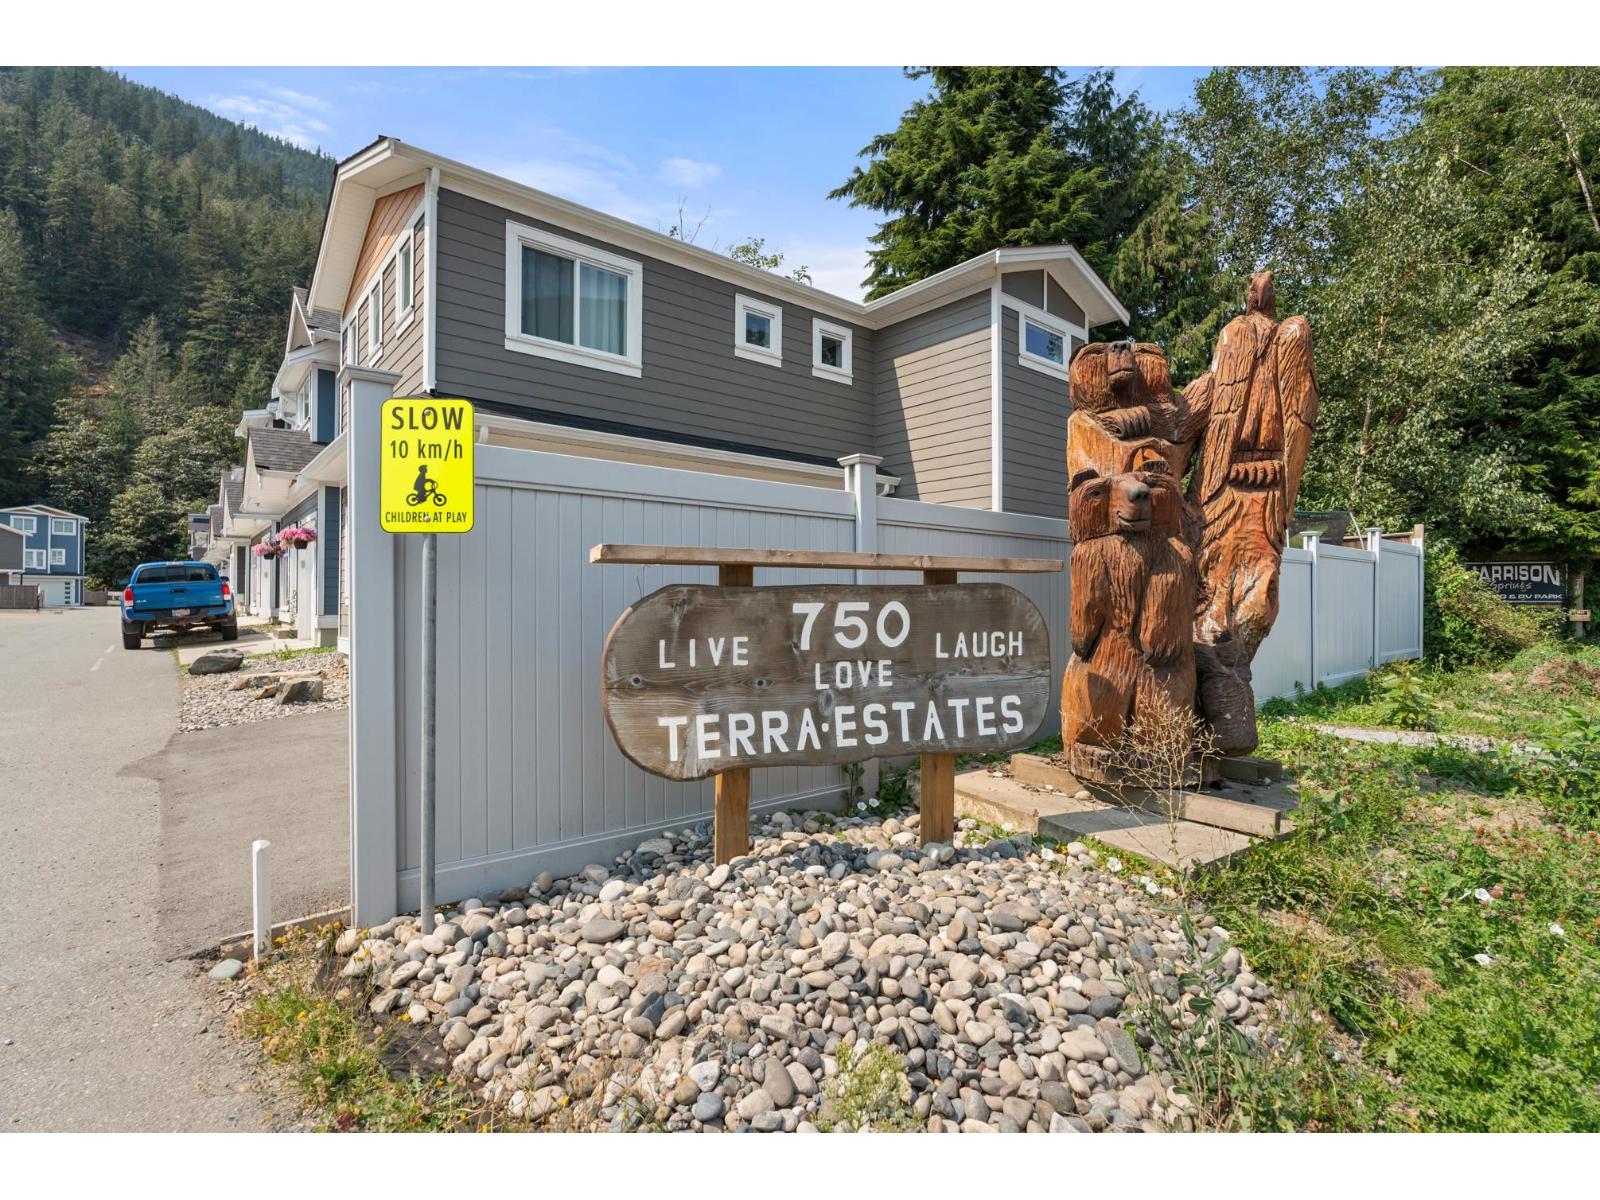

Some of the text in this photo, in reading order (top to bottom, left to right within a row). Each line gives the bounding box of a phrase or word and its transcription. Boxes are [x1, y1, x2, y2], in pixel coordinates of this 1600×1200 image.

[391, 406, 464, 430] SLOW
[390, 438, 463, 461] 10 km/h
[433, 511, 443, 523] AT
[446, 511, 467, 523] PLAY
[1472, 564, 1561, 586] ARRISON
[792, 600, 911, 651] 750
[659, 636, 749, 669] LIVE
[935, 631, 1023, 659] LAUGH
[814, 659, 893, 690] LOVE
